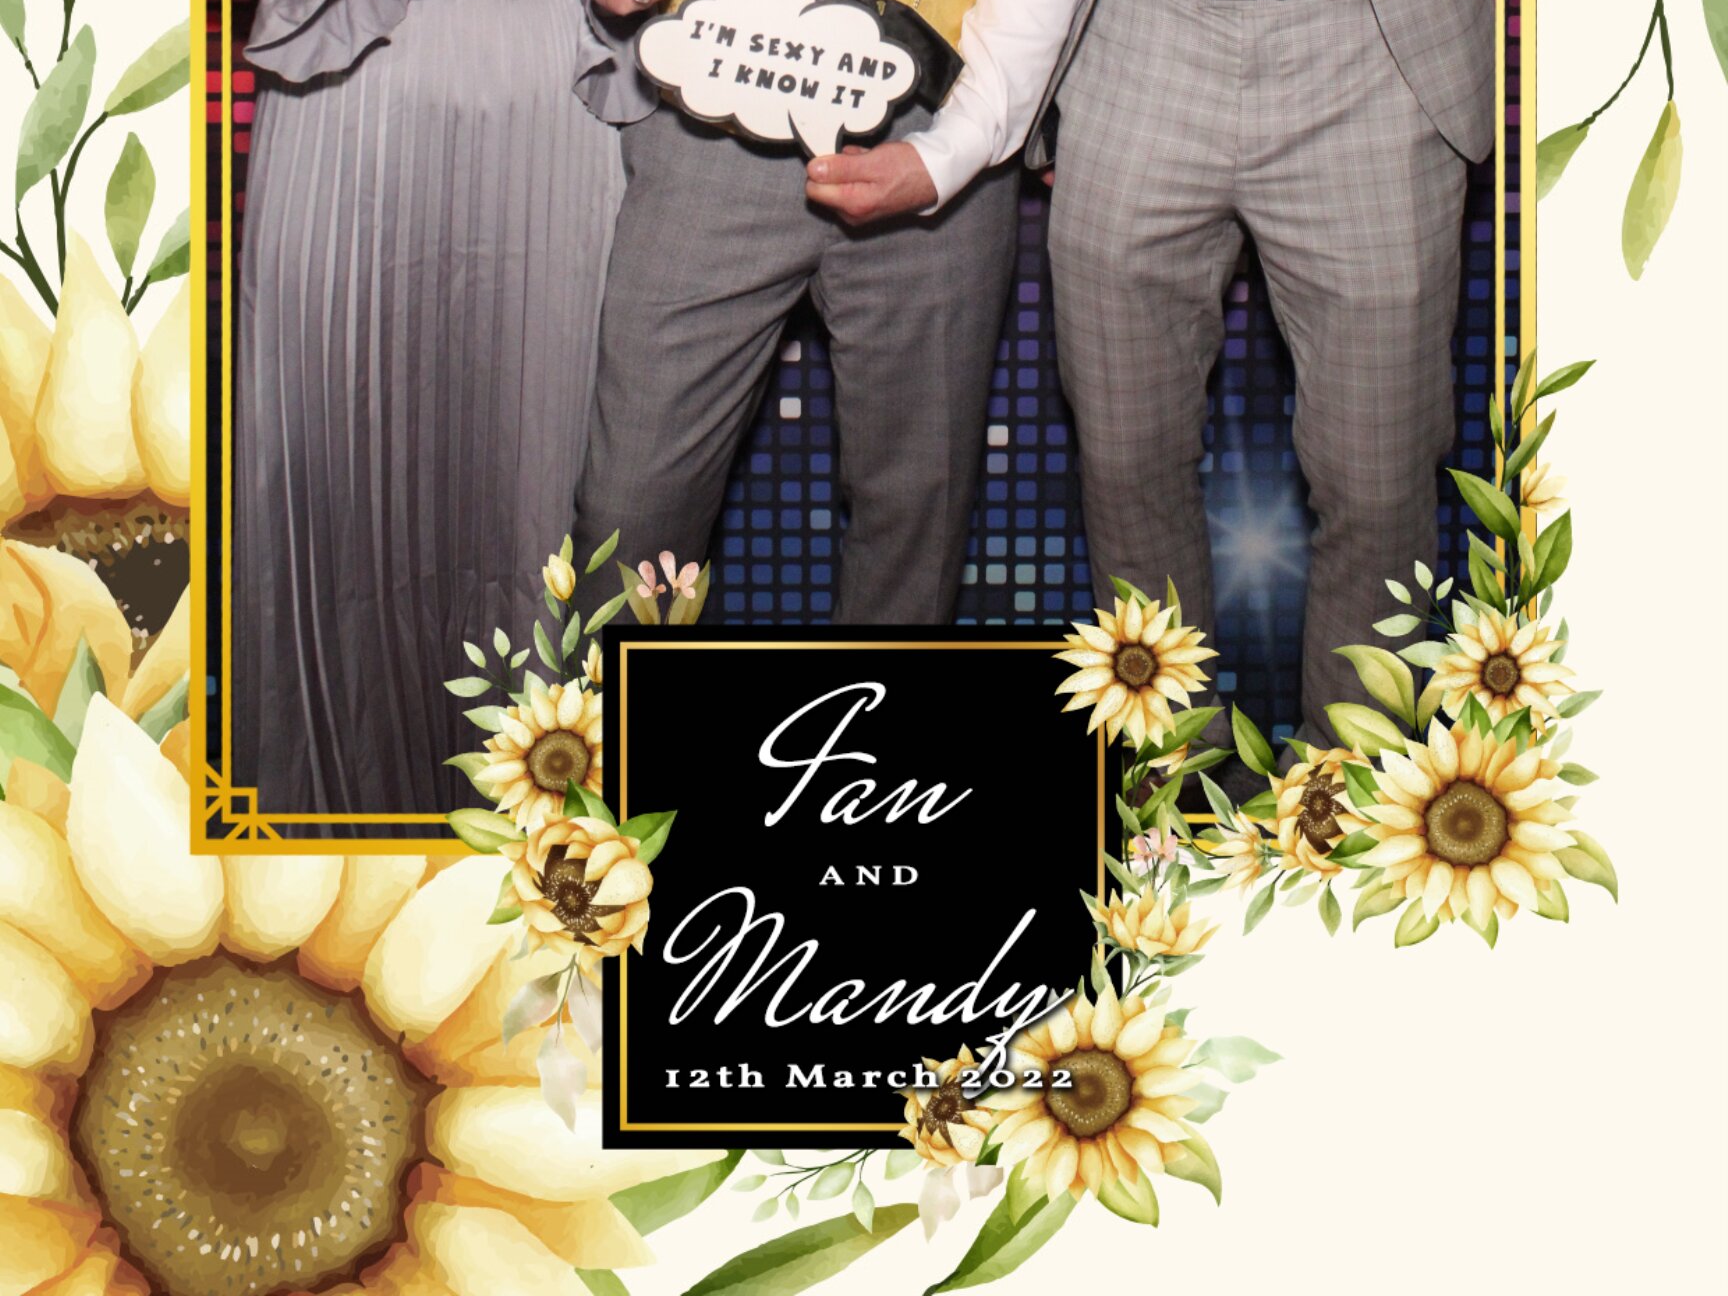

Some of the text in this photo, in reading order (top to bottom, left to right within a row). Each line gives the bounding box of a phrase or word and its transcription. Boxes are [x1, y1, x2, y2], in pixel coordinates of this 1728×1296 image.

[690, 20, 898, 81] I'M SEXY AND
[708, 58, 866, 108] I KNOW IT
